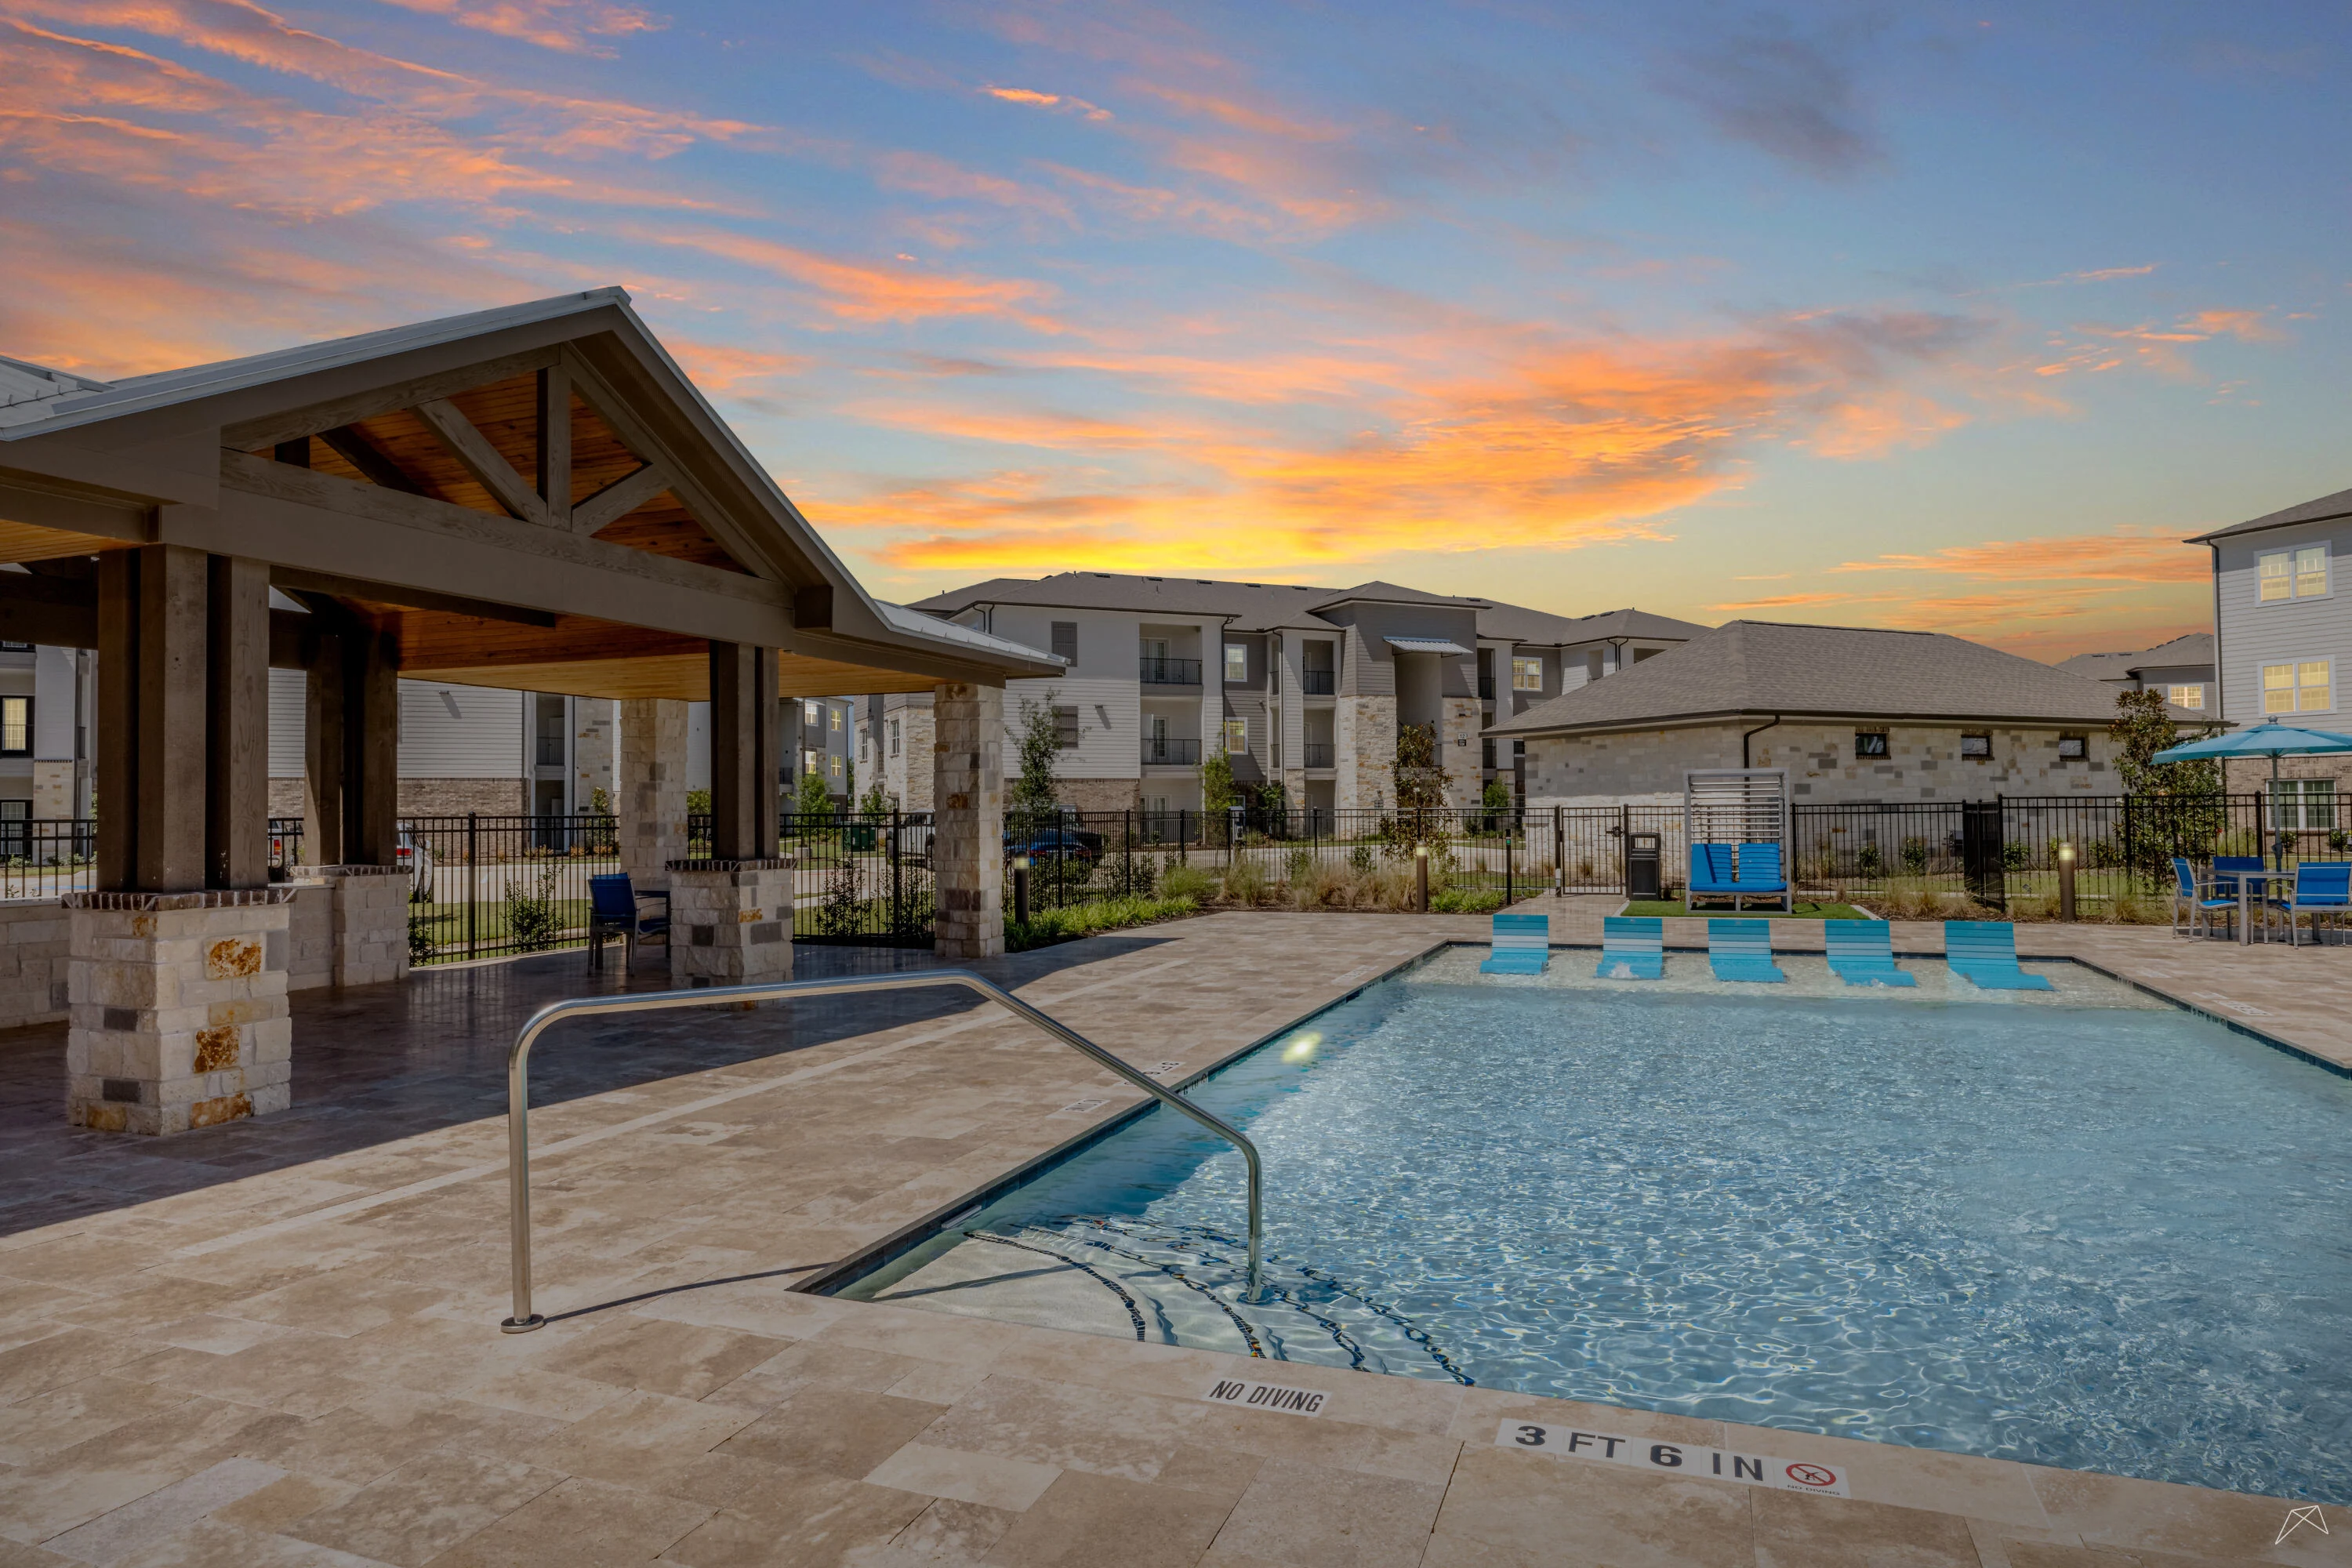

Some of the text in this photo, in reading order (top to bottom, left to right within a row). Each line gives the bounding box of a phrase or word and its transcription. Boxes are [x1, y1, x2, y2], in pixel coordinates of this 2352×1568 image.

[1209, 1381, 1323, 1412] NO DIVING
[1515, 1425, 1763, 1482] 3 FT 6 IN
